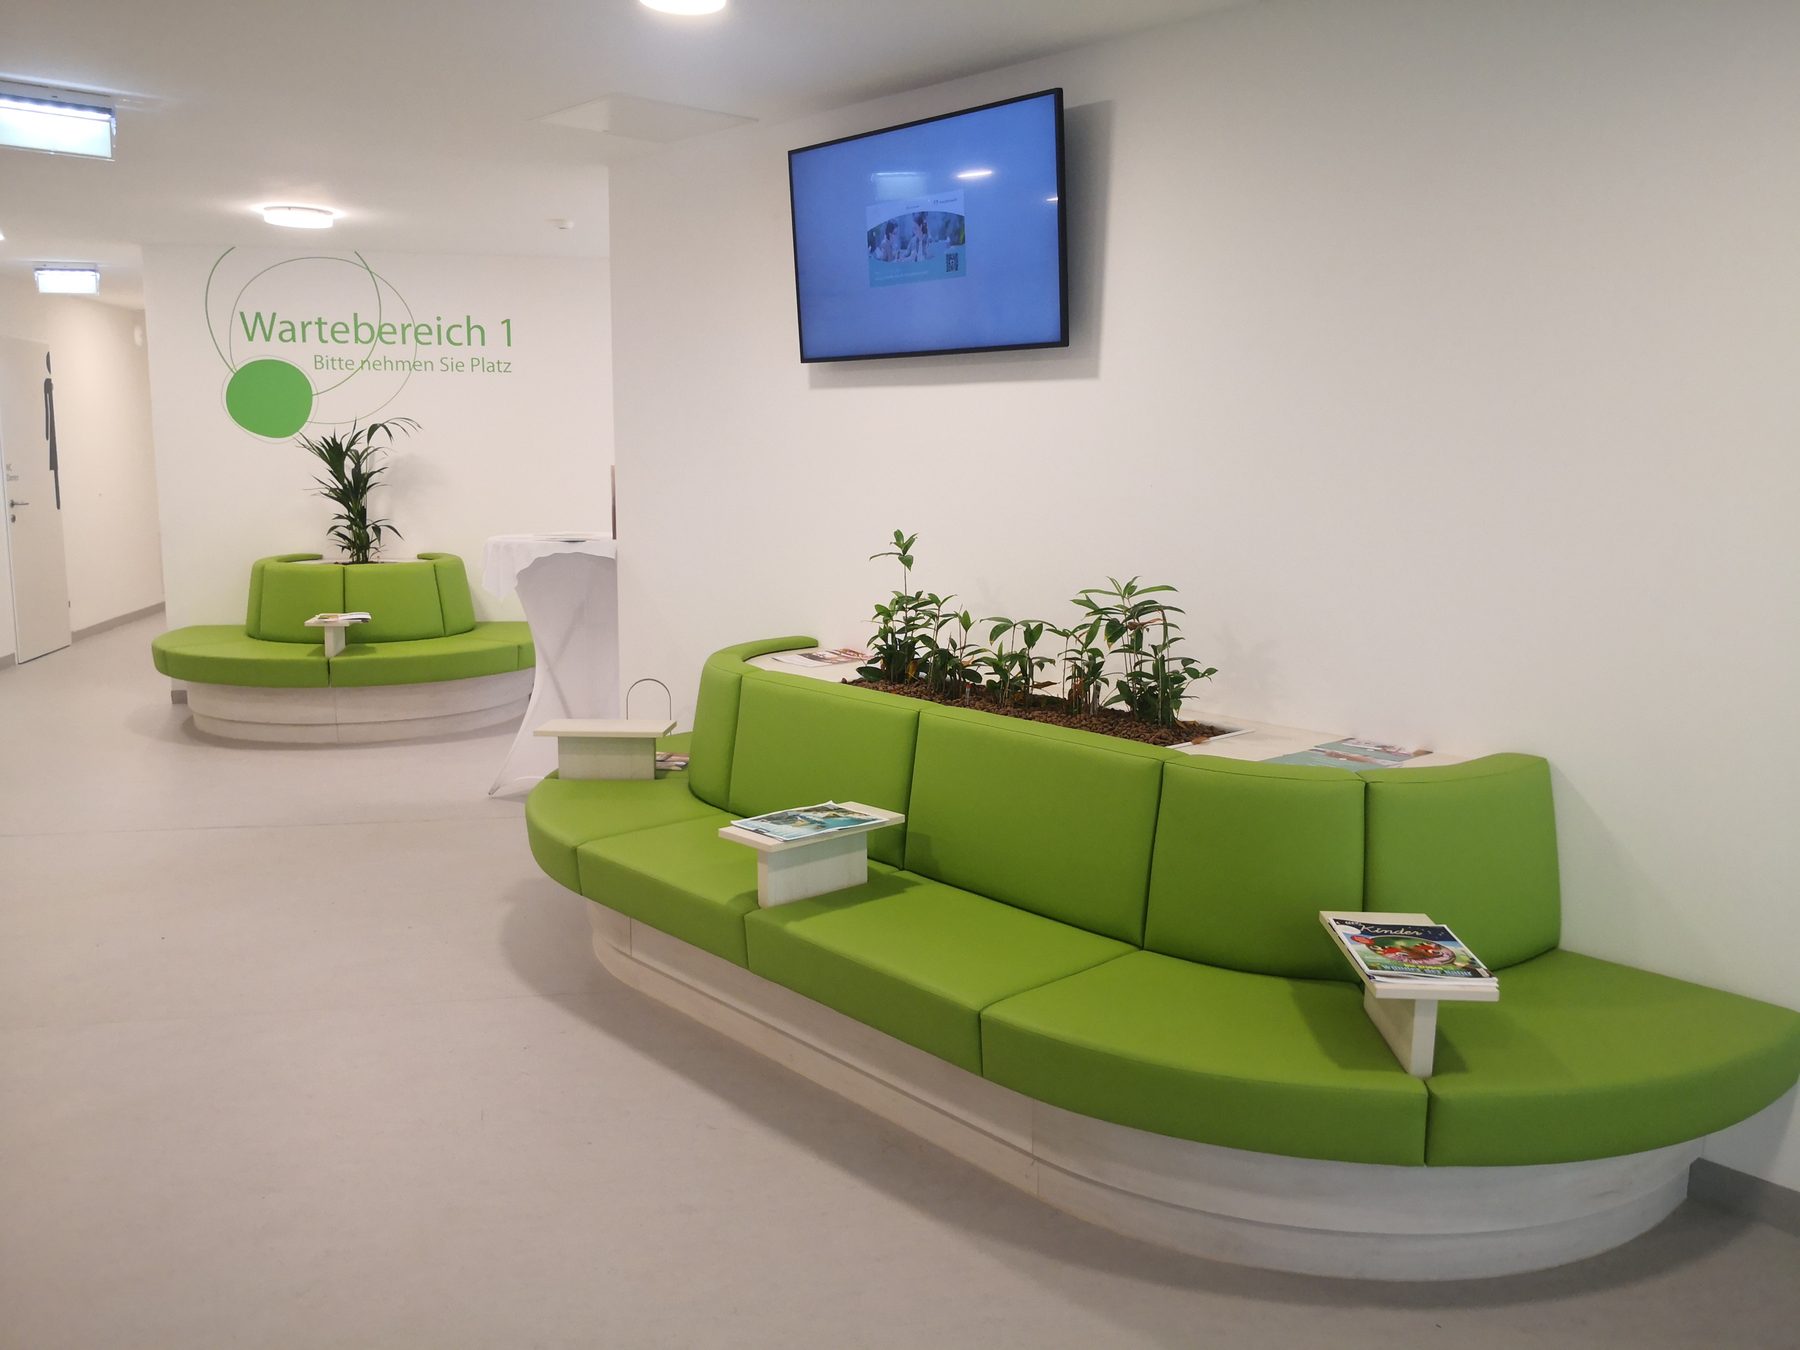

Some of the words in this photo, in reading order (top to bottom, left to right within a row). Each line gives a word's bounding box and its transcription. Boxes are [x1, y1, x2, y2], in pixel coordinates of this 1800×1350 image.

[239, 311, 486, 347] Wartebereich
[500, 318, 512, 347] 1
[313, 354, 355, 371] Bitte
[360, 355, 434, 372] nehmen
[440, 356, 465, 373] Sie
[471, 357, 512, 373] Platz
[1360, 925, 1423, 936] Kinder
